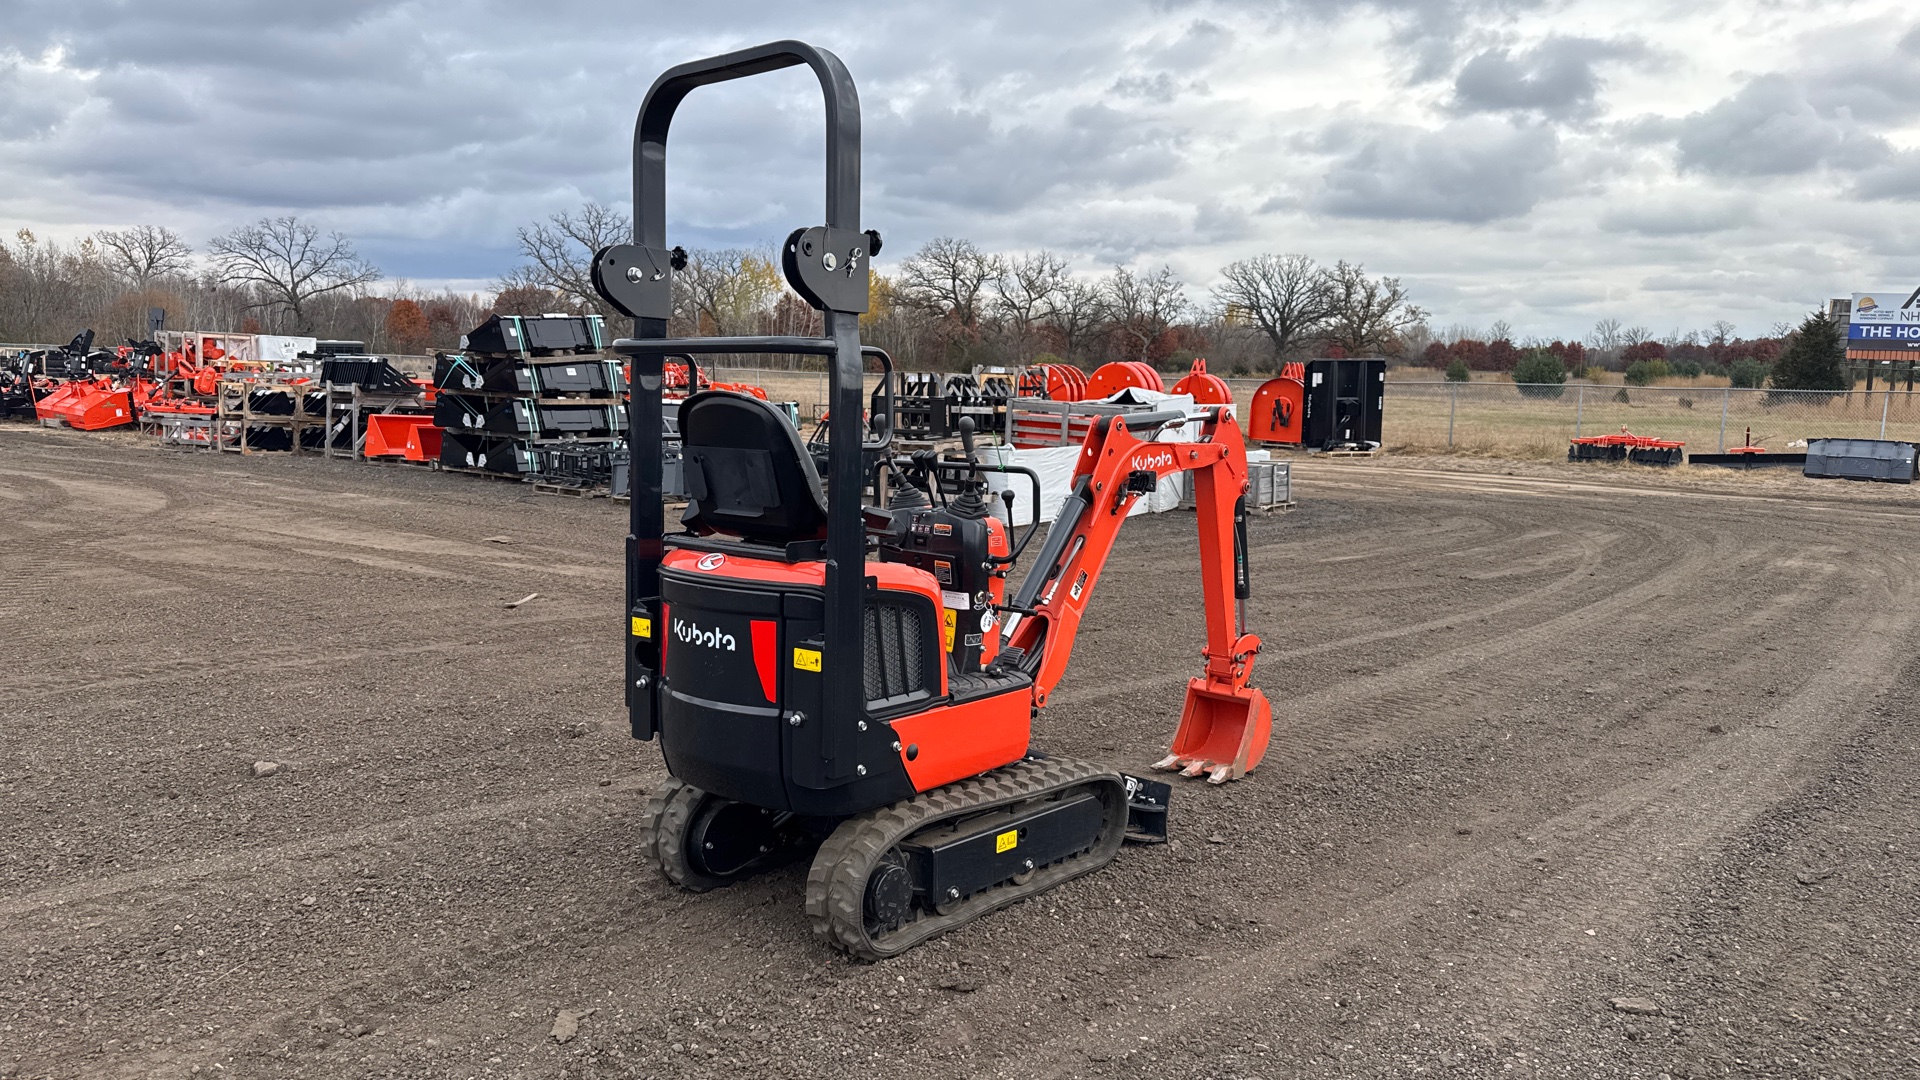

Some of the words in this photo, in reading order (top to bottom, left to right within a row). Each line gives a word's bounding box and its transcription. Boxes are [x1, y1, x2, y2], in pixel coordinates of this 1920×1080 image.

[1860, 326, 1892, 338] THE
[1896, 326, 1920, 339] HO
[1132, 451, 1172, 471] Kubota
[674, 617, 736, 651] Kubota
